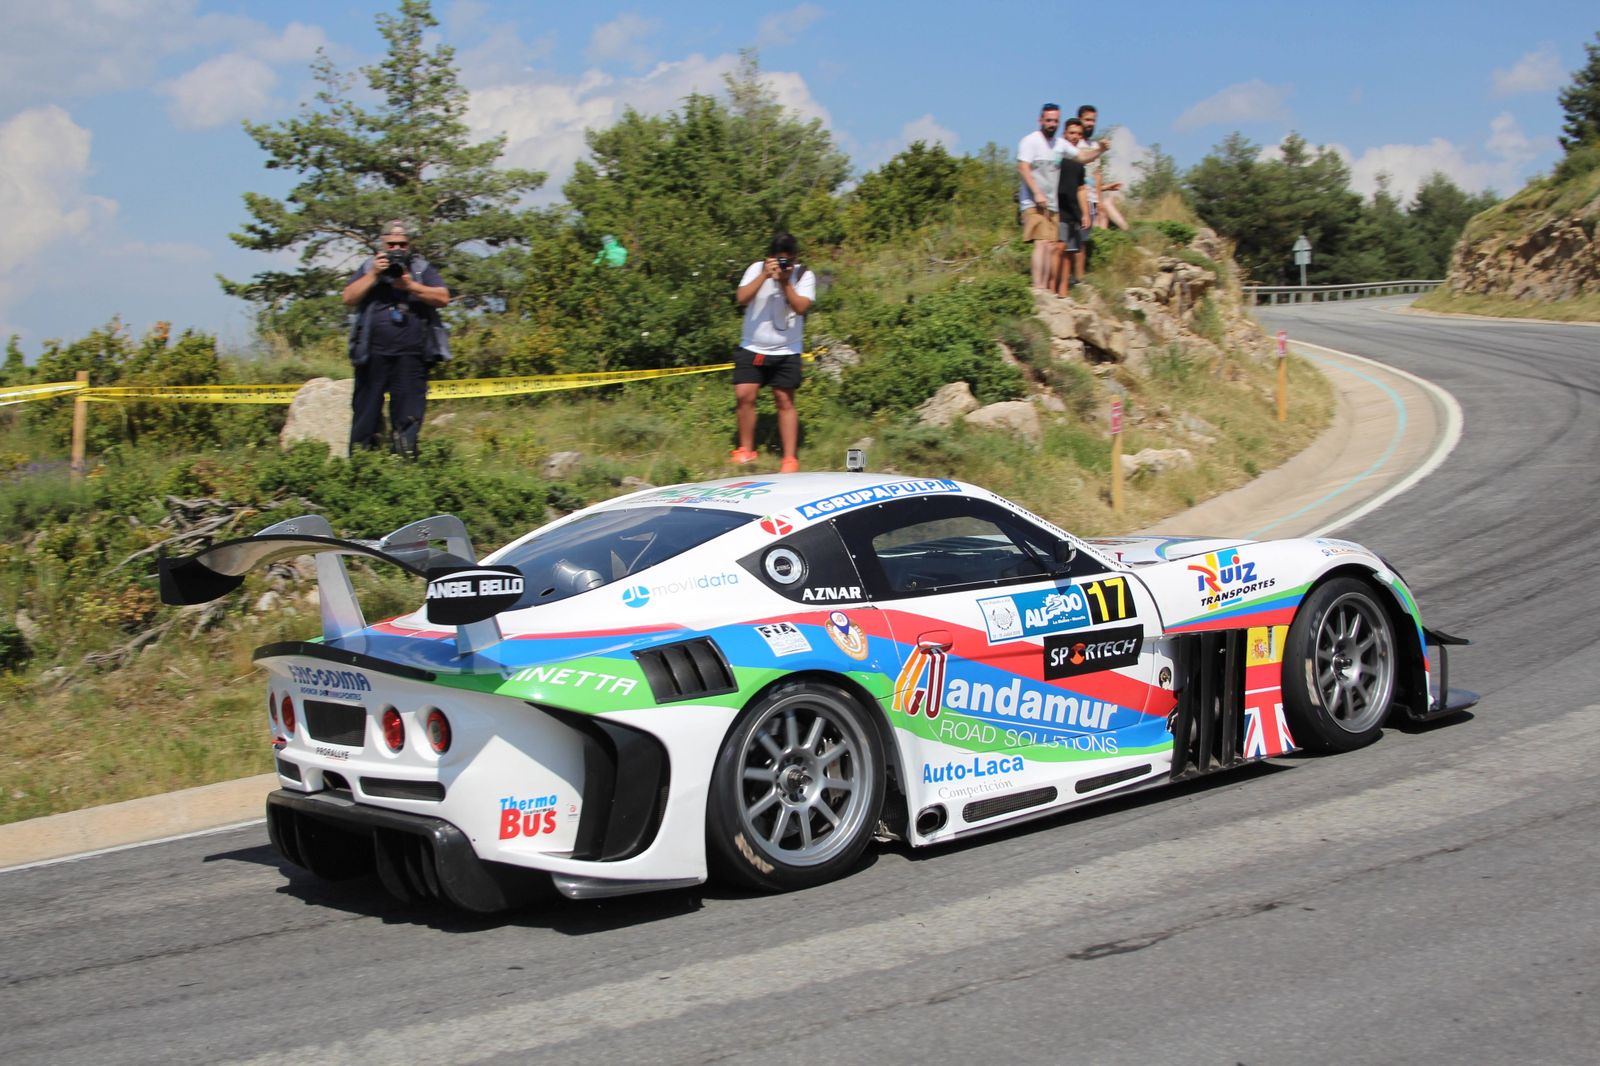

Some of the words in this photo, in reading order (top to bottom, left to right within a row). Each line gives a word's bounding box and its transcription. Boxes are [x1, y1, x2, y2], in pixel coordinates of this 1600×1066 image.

[426, 581, 477, 599] ANGEL
[479, 578, 524, 596] BELLO
[652, 573, 739, 596] movildata
[802, 586, 862, 601] AZNAR
[1201, 577, 1276, 607] TRANSPORTES
[1087, 577, 1127, 622] 17
[758, 623, 798, 638] FIA
[1050, 638, 1137, 667] SPORTECH
[939, 719, 997, 745] ROAD
[1004, 728, 1119, 755] SOLUTIONS
[923, 755, 1025, 785] Auto-Laca
[500, 794, 558, 812] Thermo
[499, 808, 557, 840] BUS
